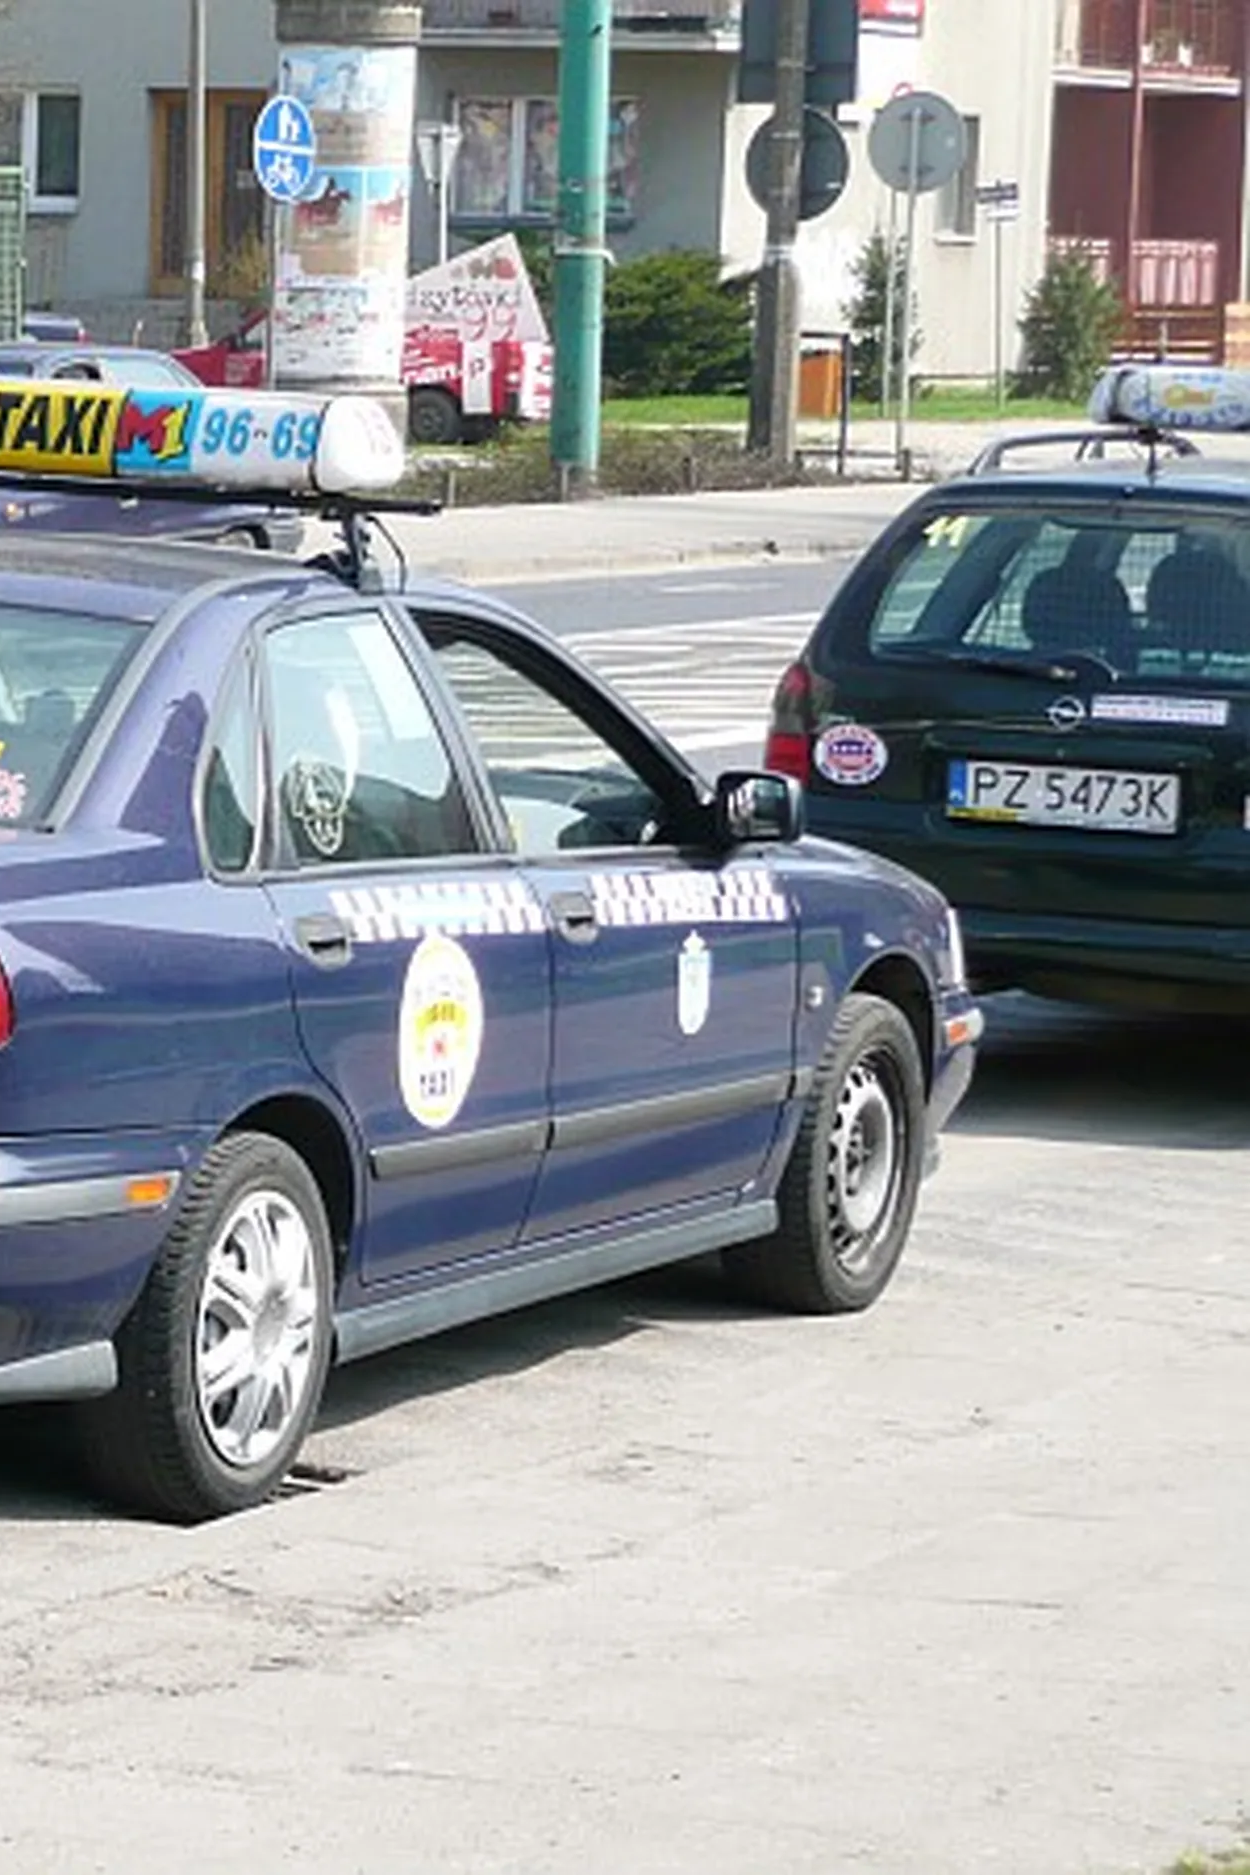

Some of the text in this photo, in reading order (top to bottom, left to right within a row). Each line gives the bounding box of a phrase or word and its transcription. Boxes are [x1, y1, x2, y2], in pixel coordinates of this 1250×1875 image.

[115, 401, 187, 460] M1
[923, 516, 968, 547] 11
[973, 767, 1171, 820] PZ 5473K
